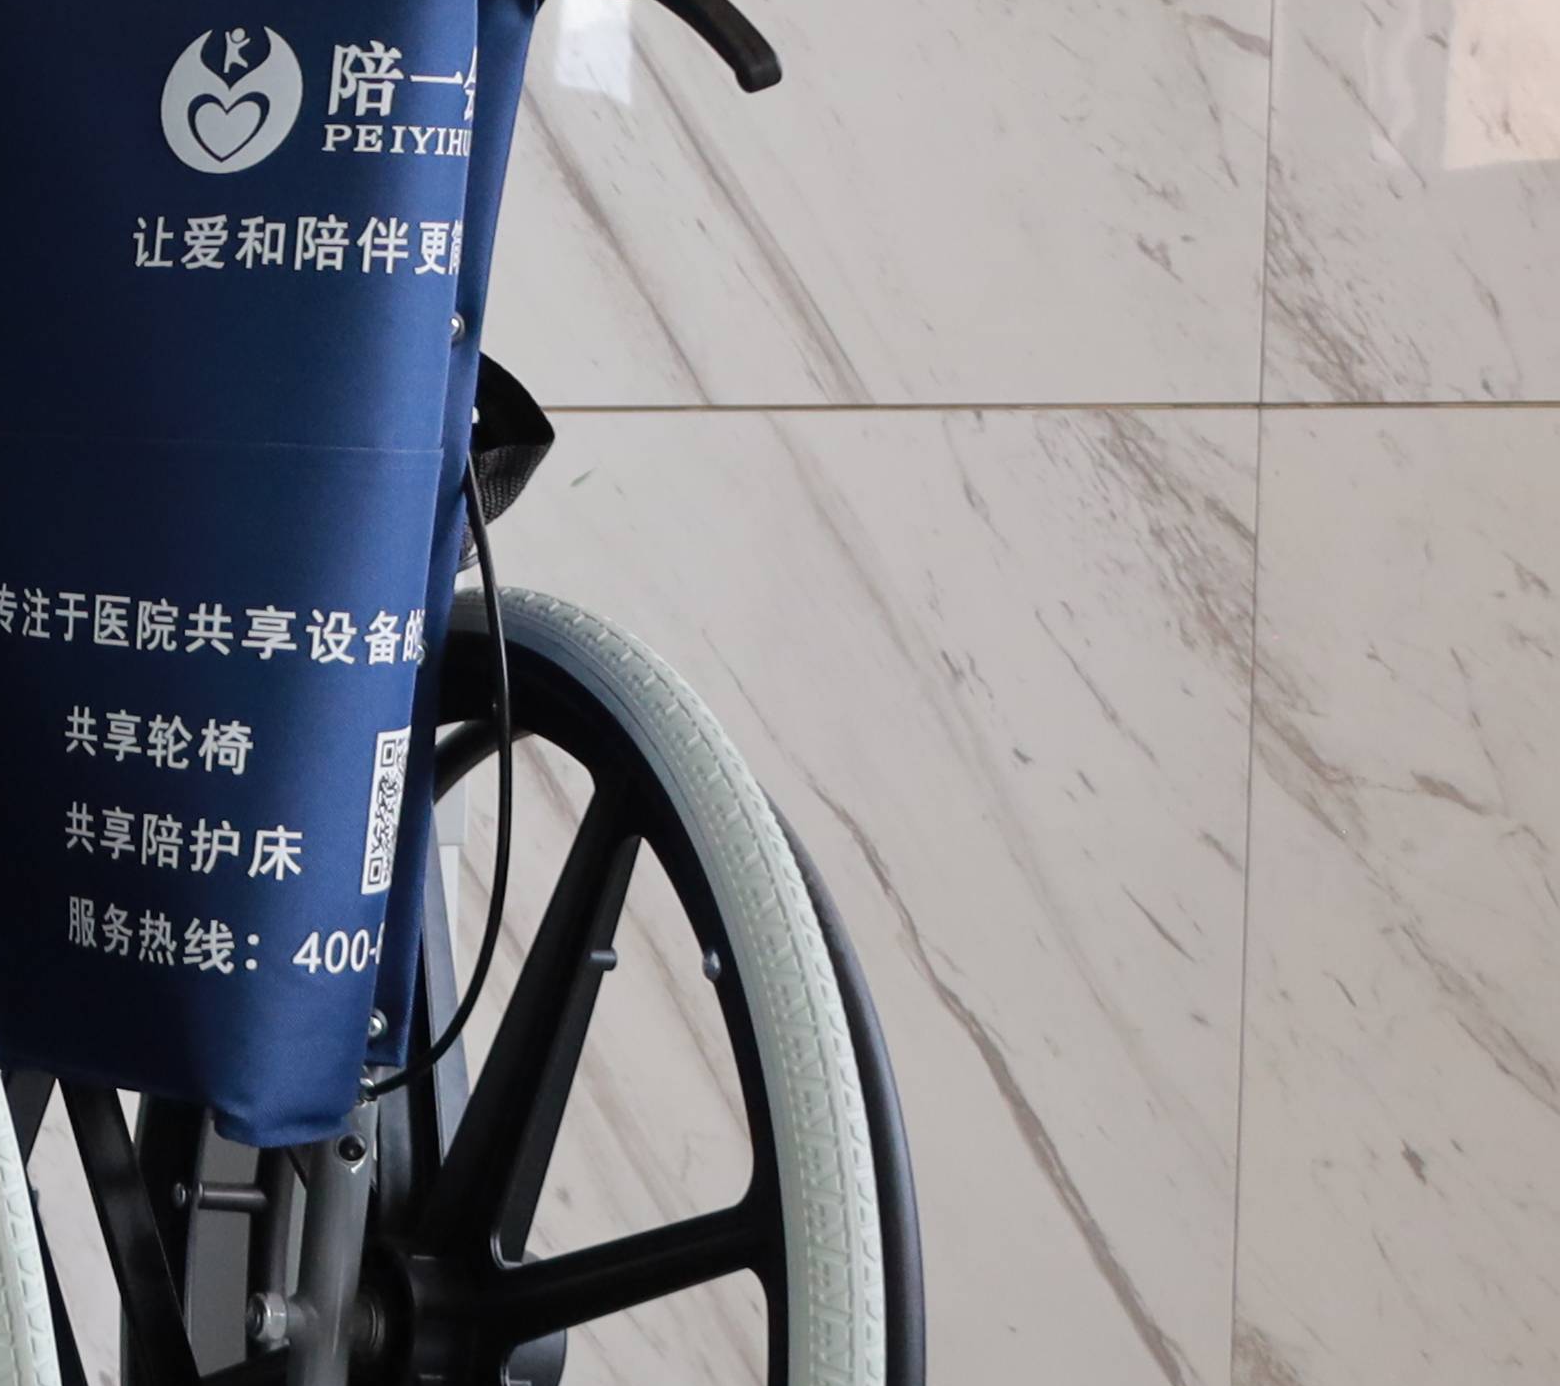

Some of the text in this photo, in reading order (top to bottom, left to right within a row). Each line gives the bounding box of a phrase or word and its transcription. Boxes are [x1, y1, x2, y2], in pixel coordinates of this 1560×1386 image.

[64, 705, 254, 776] 共享轮椅
[64, 801, 304, 881] 共享陪护床
[67, 896, 260, 975] 服务热线：
